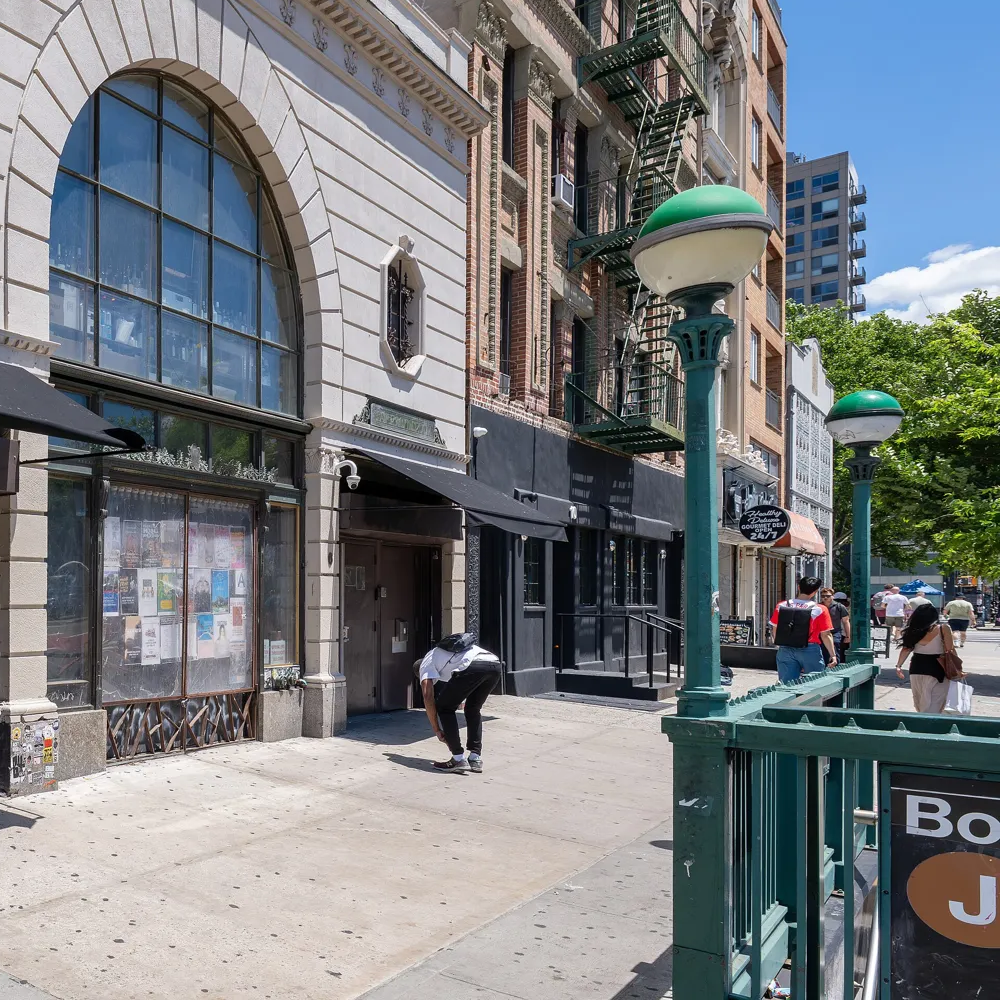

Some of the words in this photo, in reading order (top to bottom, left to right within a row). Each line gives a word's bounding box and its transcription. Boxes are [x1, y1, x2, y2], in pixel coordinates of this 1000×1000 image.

[744, 509, 782, 518] Healthy
[741, 522, 771, 530] GOURMET
[749, 531, 778, 540] 24/7
[948, 874, 997, 926] J
